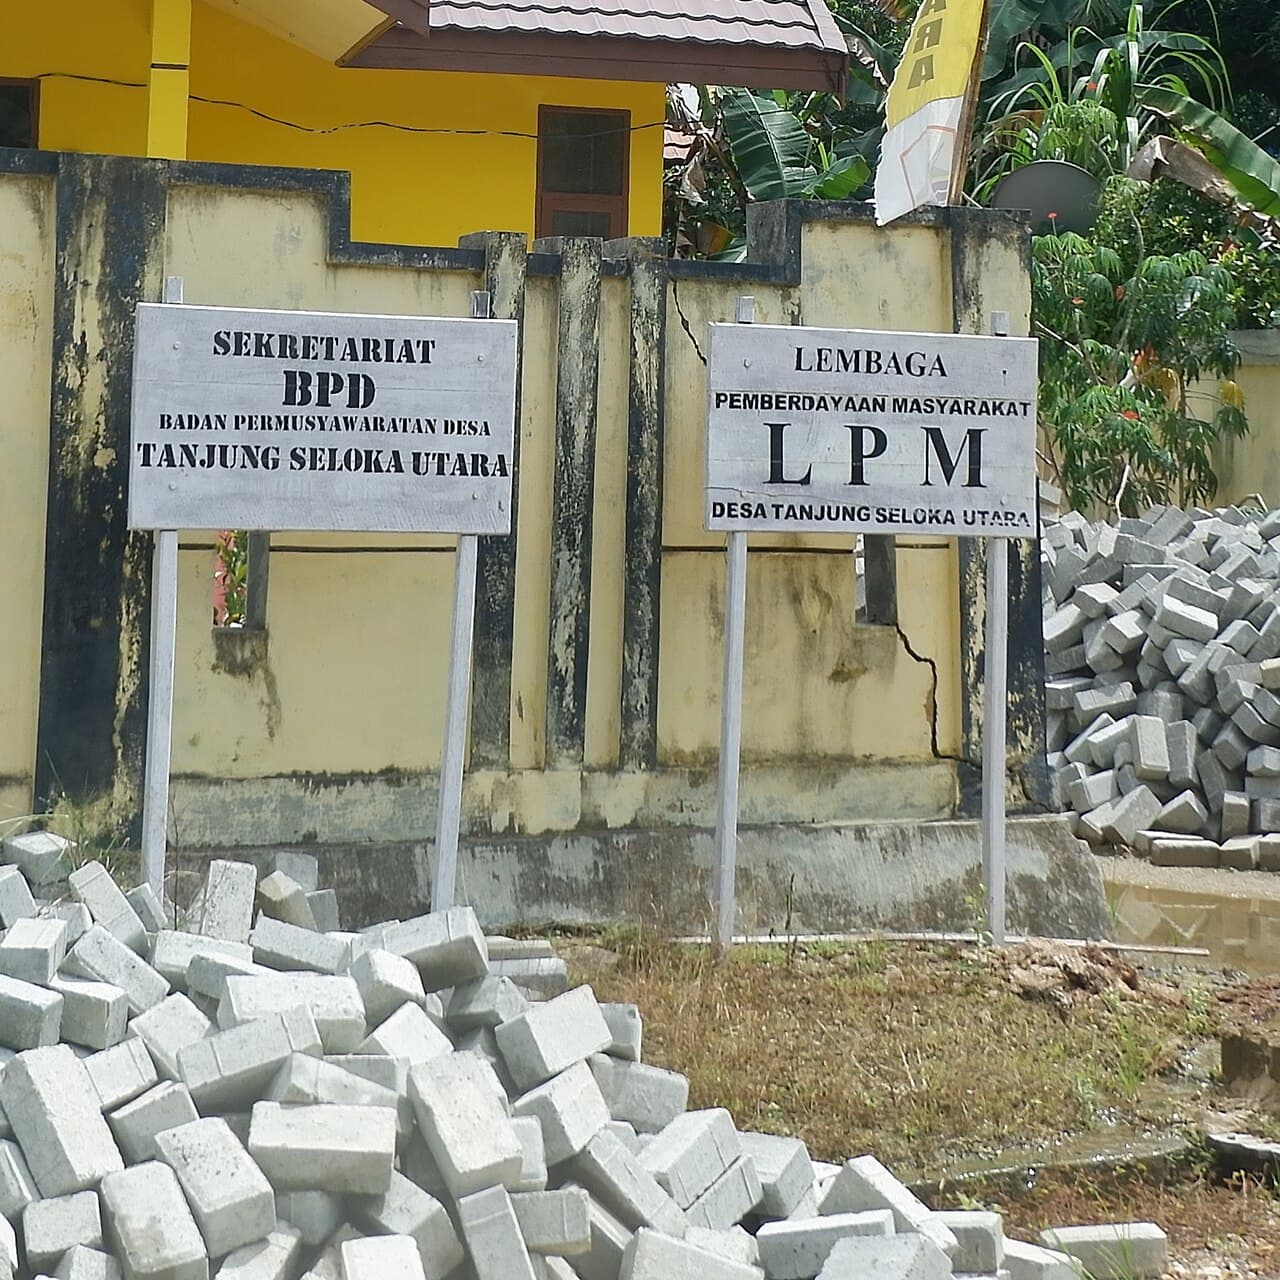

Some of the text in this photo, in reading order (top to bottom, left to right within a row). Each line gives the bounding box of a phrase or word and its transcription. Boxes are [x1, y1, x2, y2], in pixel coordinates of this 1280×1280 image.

[213, 330, 435, 364] SEKRETARIAT
[794, 347, 947, 377] LEMBAGA
[282, 370, 376, 409] BPD
[715, 393, 1032, 417] PEMBERDAYAAN MASYARAKAT
[159, 413, 490, 436] BADAN PERMUSYAWARATAN DESA
[137, 443, 509, 477] TANJUNG SELOKA UTARA
[712, 502, 1030, 528] DESA TANJUNG SELOKA UTARA
